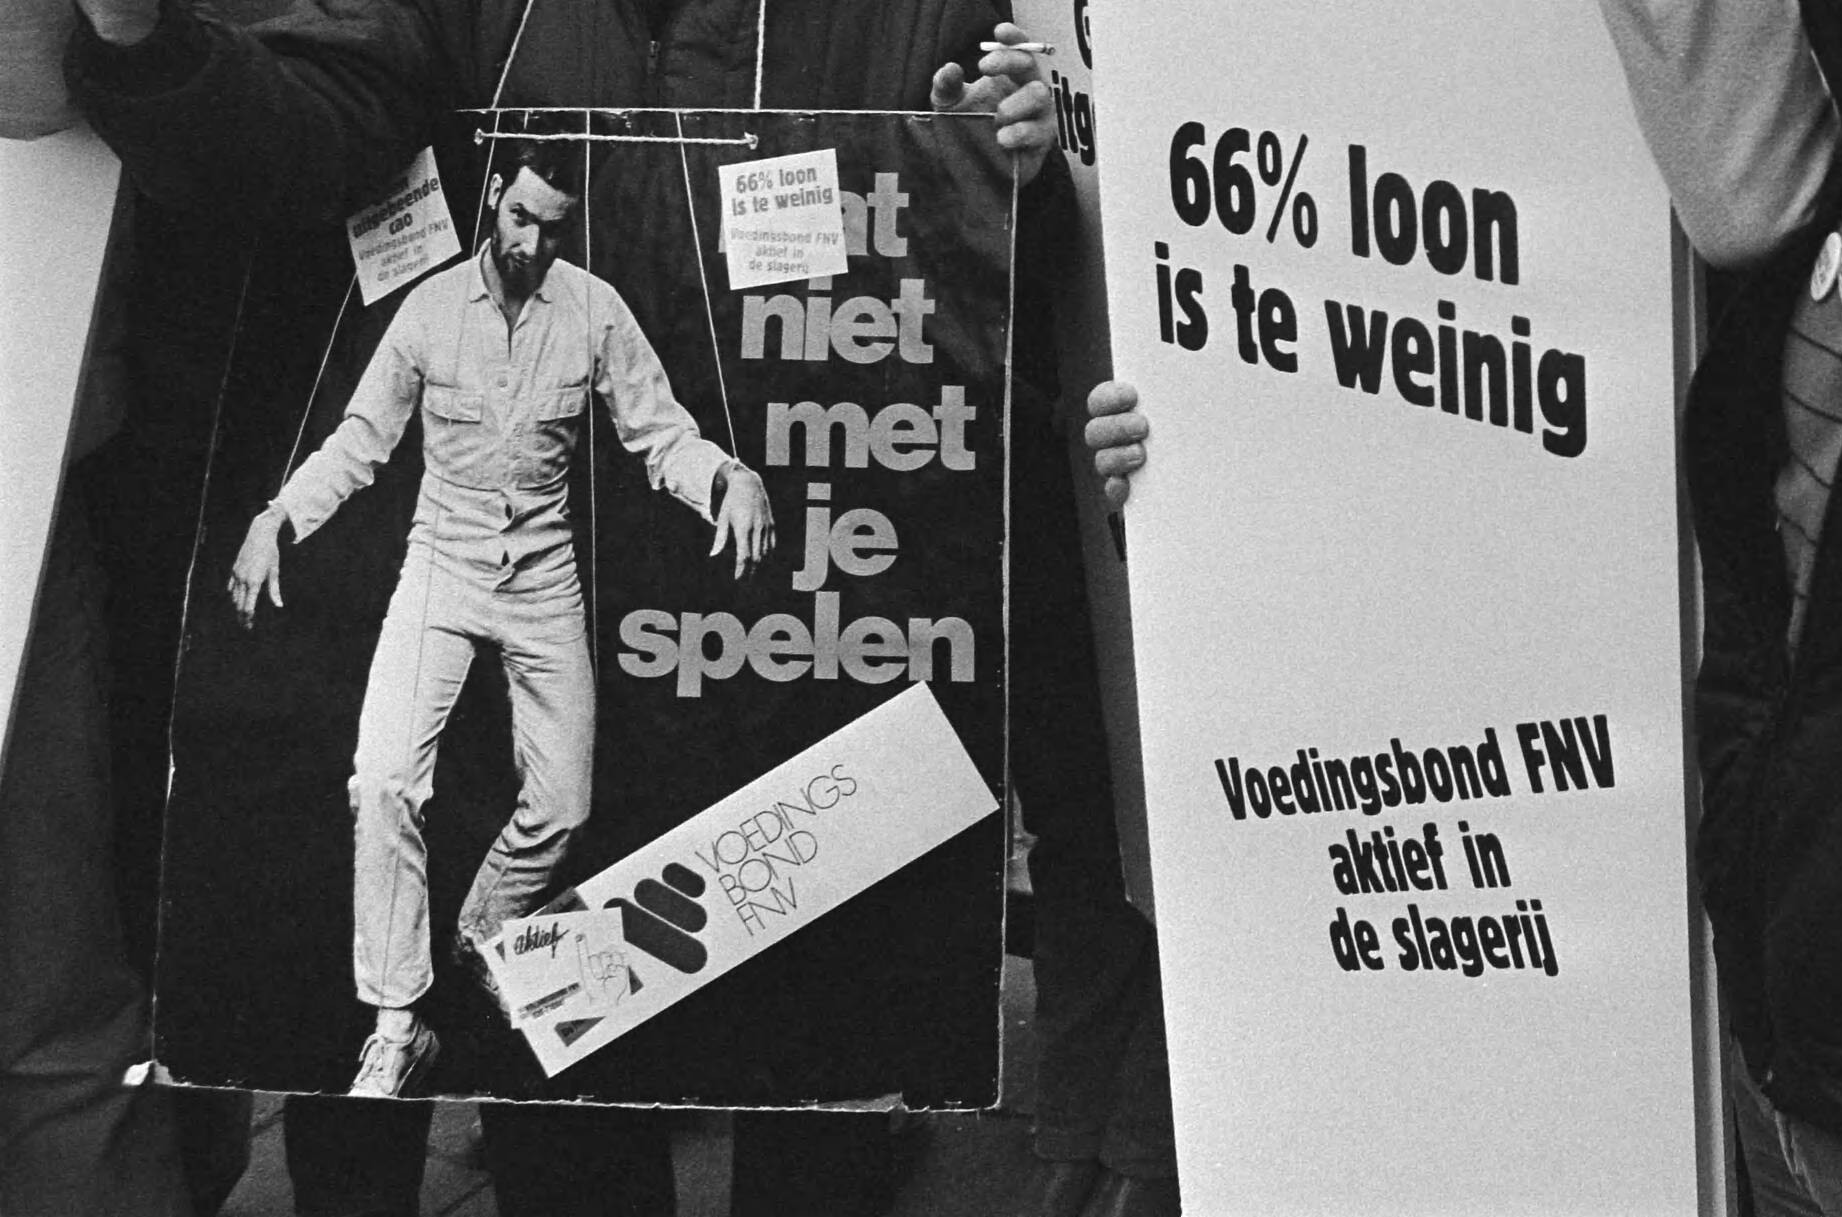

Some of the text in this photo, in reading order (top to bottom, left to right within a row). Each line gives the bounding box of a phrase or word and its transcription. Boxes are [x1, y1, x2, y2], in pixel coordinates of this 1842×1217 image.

[736, 168, 817, 193] 66% loon
[752, 195, 768, 212] te
[775, 185, 833, 209] weinig
[1170, 122, 1519, 285] 66% loon
[741, 277, 935, 363] niet
[1155, 241, 1587, 458] is te weinig
[766, 385, 976, 471] met
[792, 483, 899, 591] je
[617, 591, 976, 698] spelen
[1215, 715, 1614, 820] Voedingsbond FNV
[694, 764, 857, 873] VOEDINGS
[1328, 821, 1511, 895] aktief in
[718, 830, 818, 907] BOND
[736, 878, 798, 936] FNV
[1330, 899, 1558, 977] de slagerij
